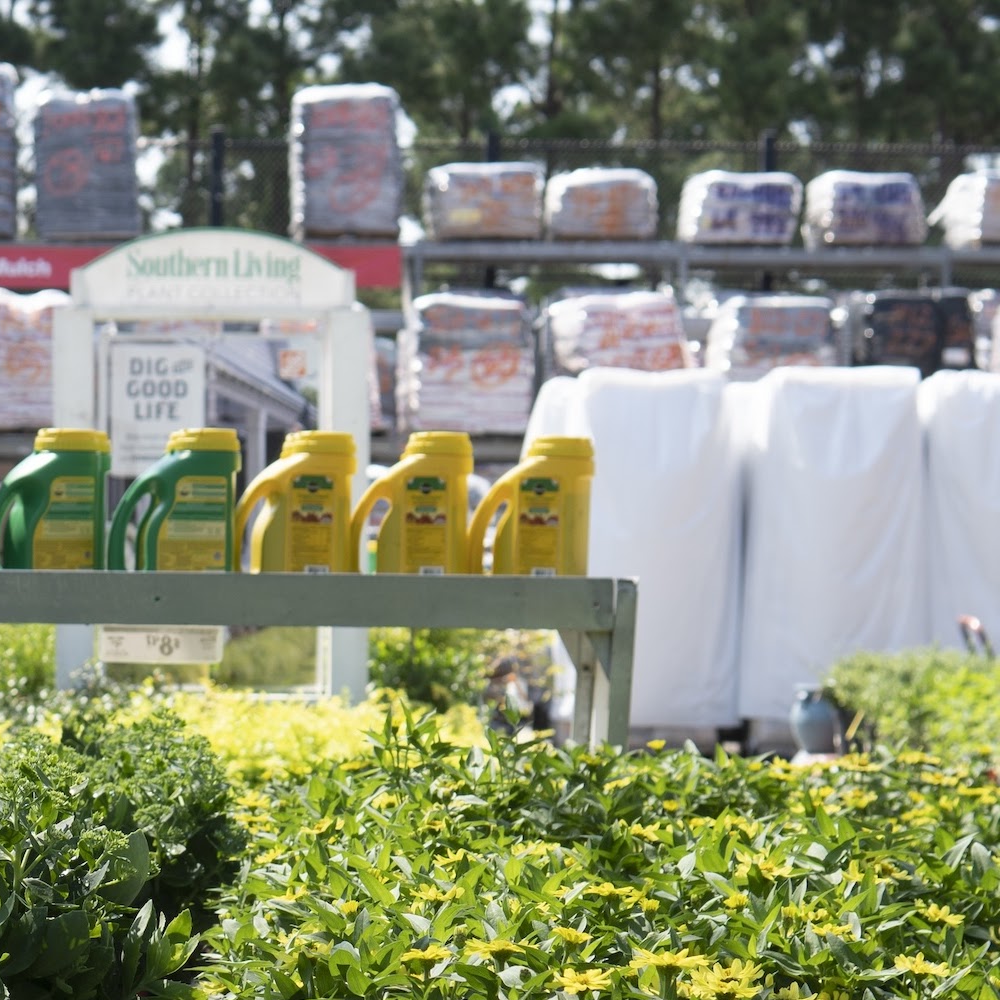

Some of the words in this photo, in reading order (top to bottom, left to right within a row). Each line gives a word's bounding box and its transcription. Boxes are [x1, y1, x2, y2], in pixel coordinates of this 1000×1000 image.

[126, 249, 229, 278] Southern
[233, 249, 301, 284] Living
[129, 357, 168, 376] DIG
[126, 379, 188, 399] GOOD
[134, 401, 179, 420] LIFE
